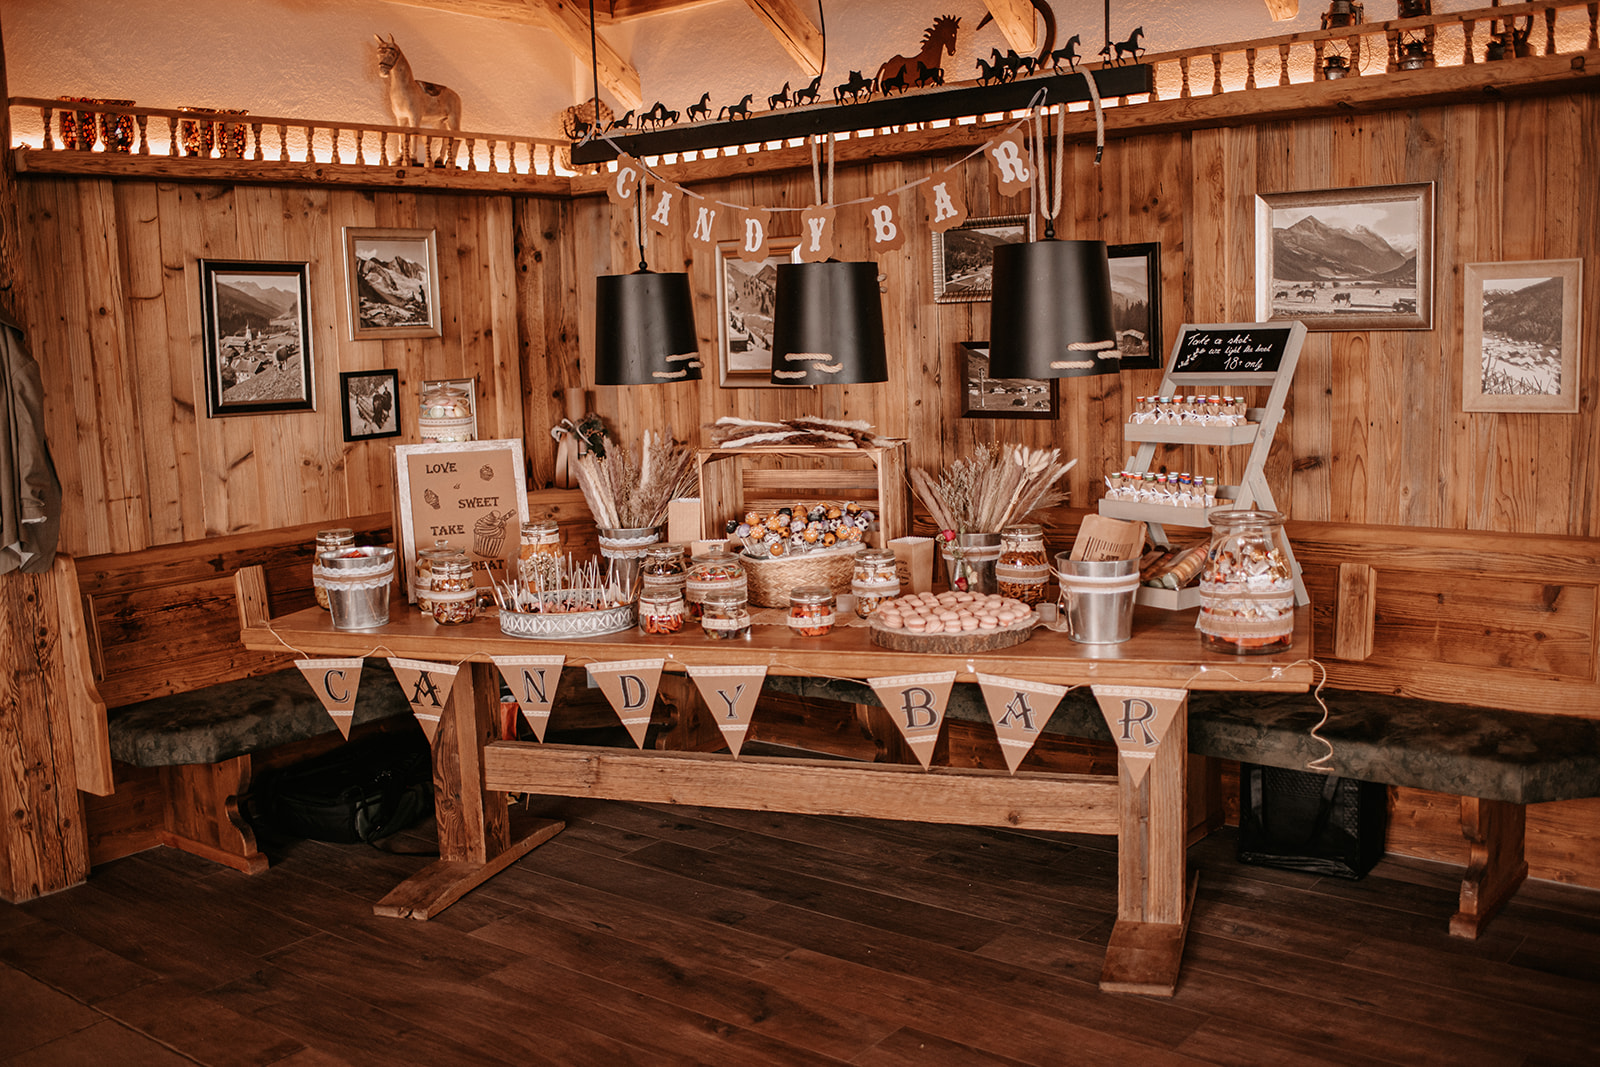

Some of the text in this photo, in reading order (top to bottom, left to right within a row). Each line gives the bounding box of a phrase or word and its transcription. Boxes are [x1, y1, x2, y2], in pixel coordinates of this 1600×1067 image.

[1188, 332, 1211, 346] Take
[1244, 357, 1264, 371] only
[425, 461, 458, 474] LOVE
[458, 496, 500, 509] SWEET
[430, 524, 466, 537] TAKE
[472, 559, 505, 572] REAT
